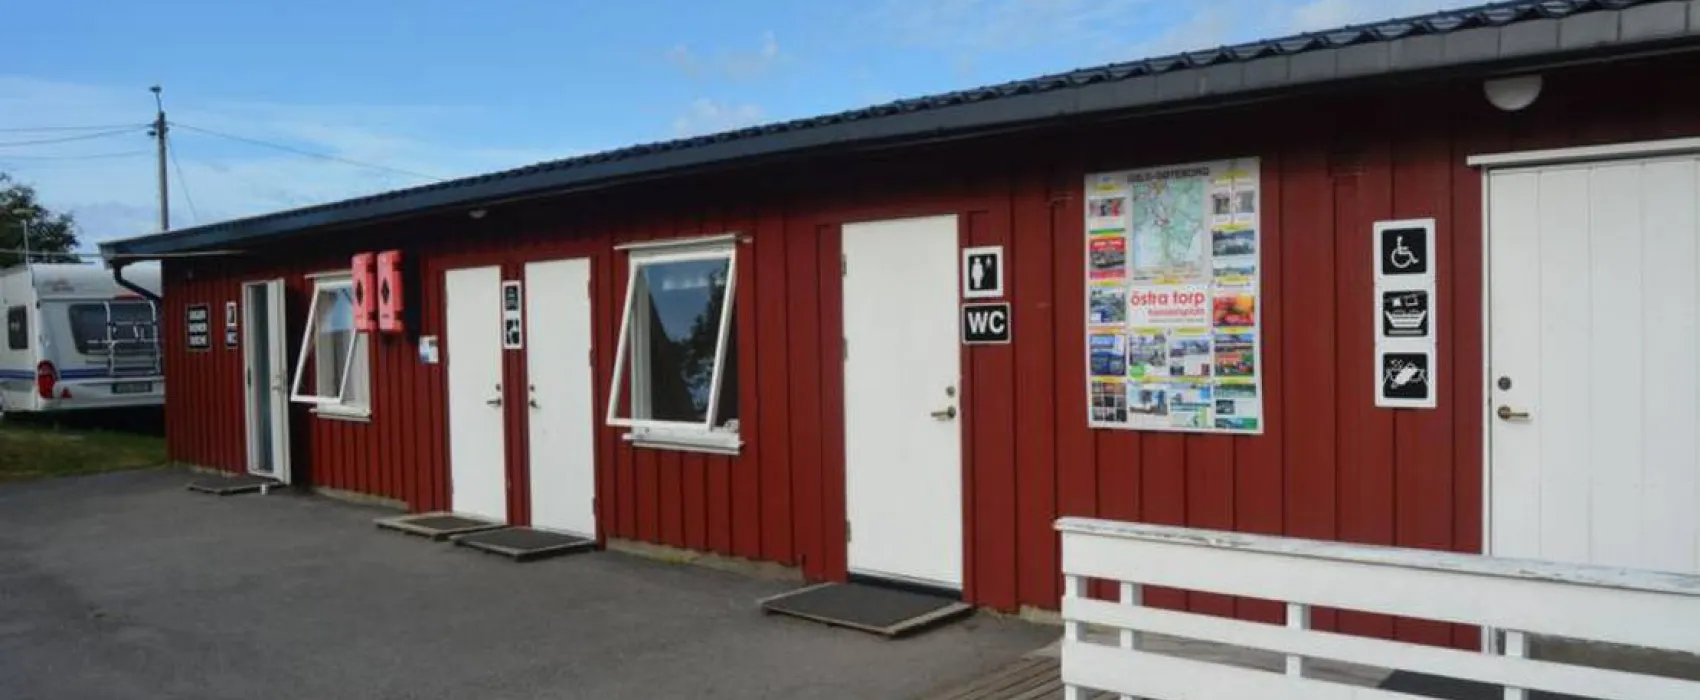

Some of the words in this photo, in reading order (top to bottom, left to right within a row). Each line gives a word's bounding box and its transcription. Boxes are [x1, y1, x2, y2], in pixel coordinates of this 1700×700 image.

[1131, 290, 1168, 306] östra
[1172, 290, 1205, 307] torp
[967, 311, 1005, 334] WC
